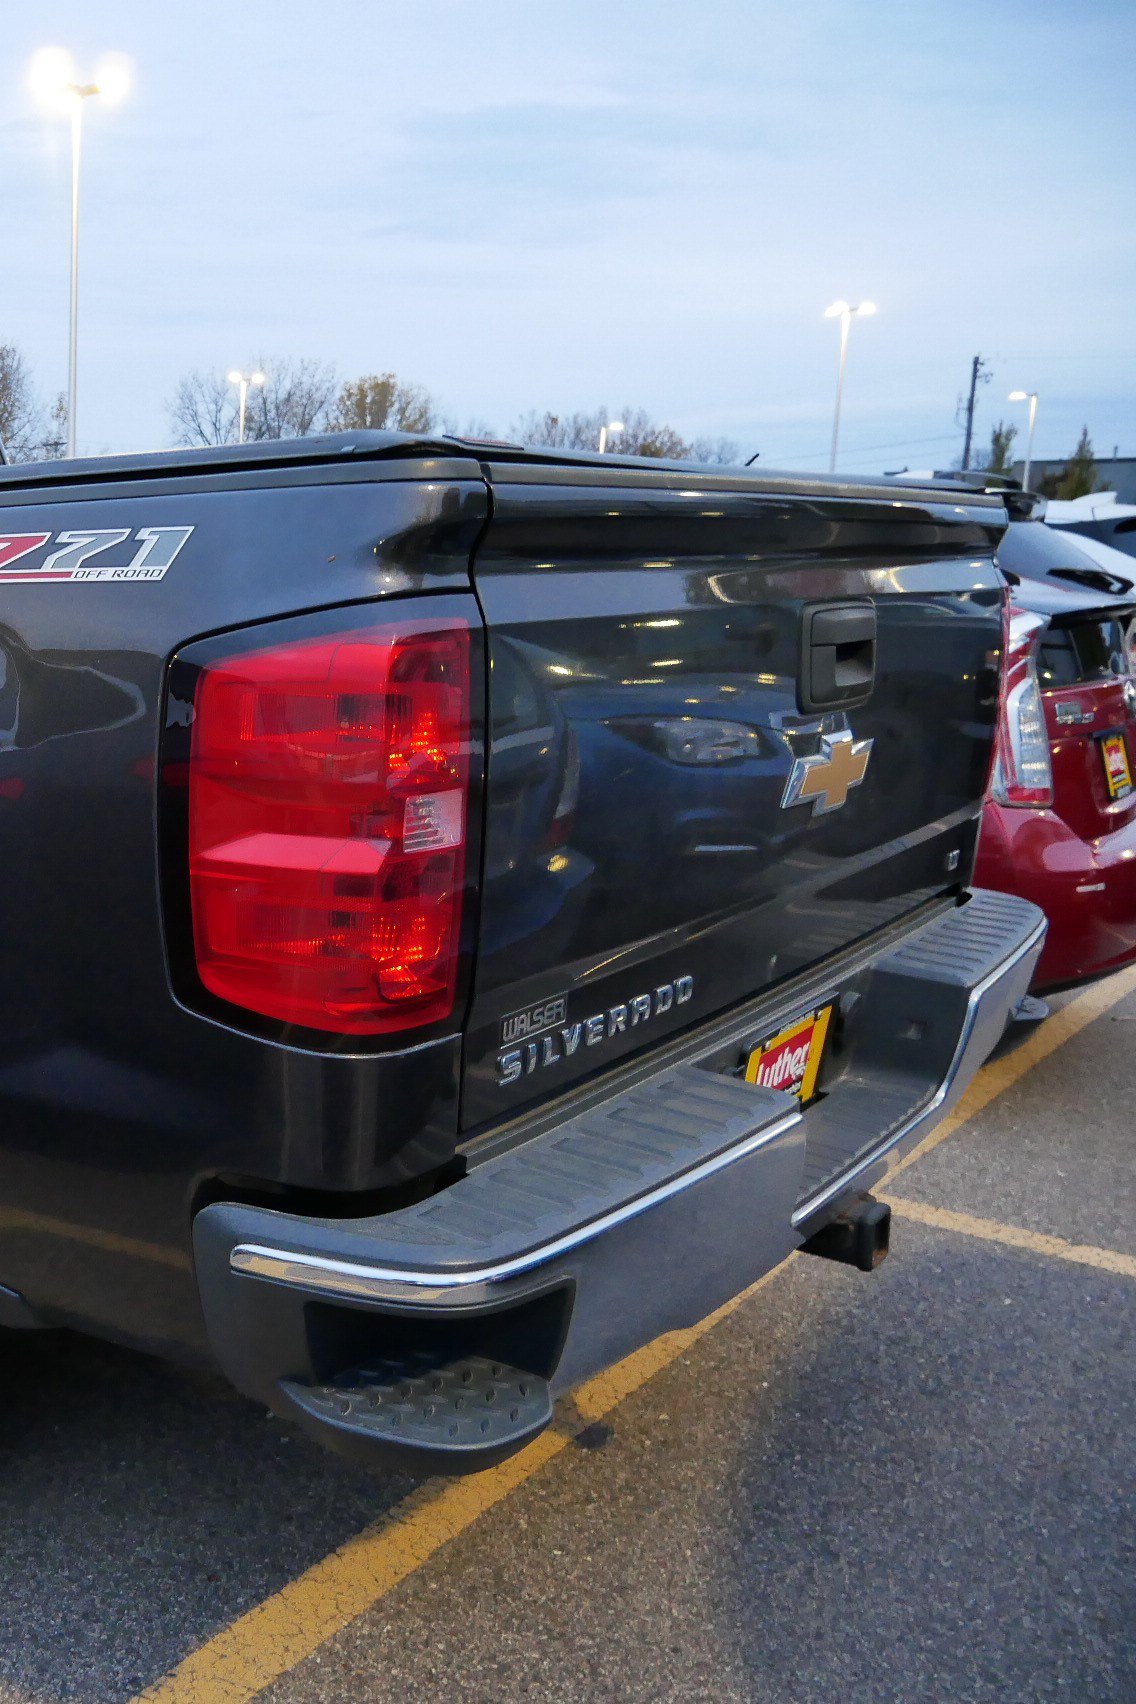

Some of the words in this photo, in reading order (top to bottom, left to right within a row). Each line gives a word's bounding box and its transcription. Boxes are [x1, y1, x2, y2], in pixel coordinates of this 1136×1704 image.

[73, 569, 109, 580] OFF
[111, 568, 163, 579] ROAD
[497, 974, 693, 1087] SILVERADO
[502, 999, 565, 1043] WALSER
